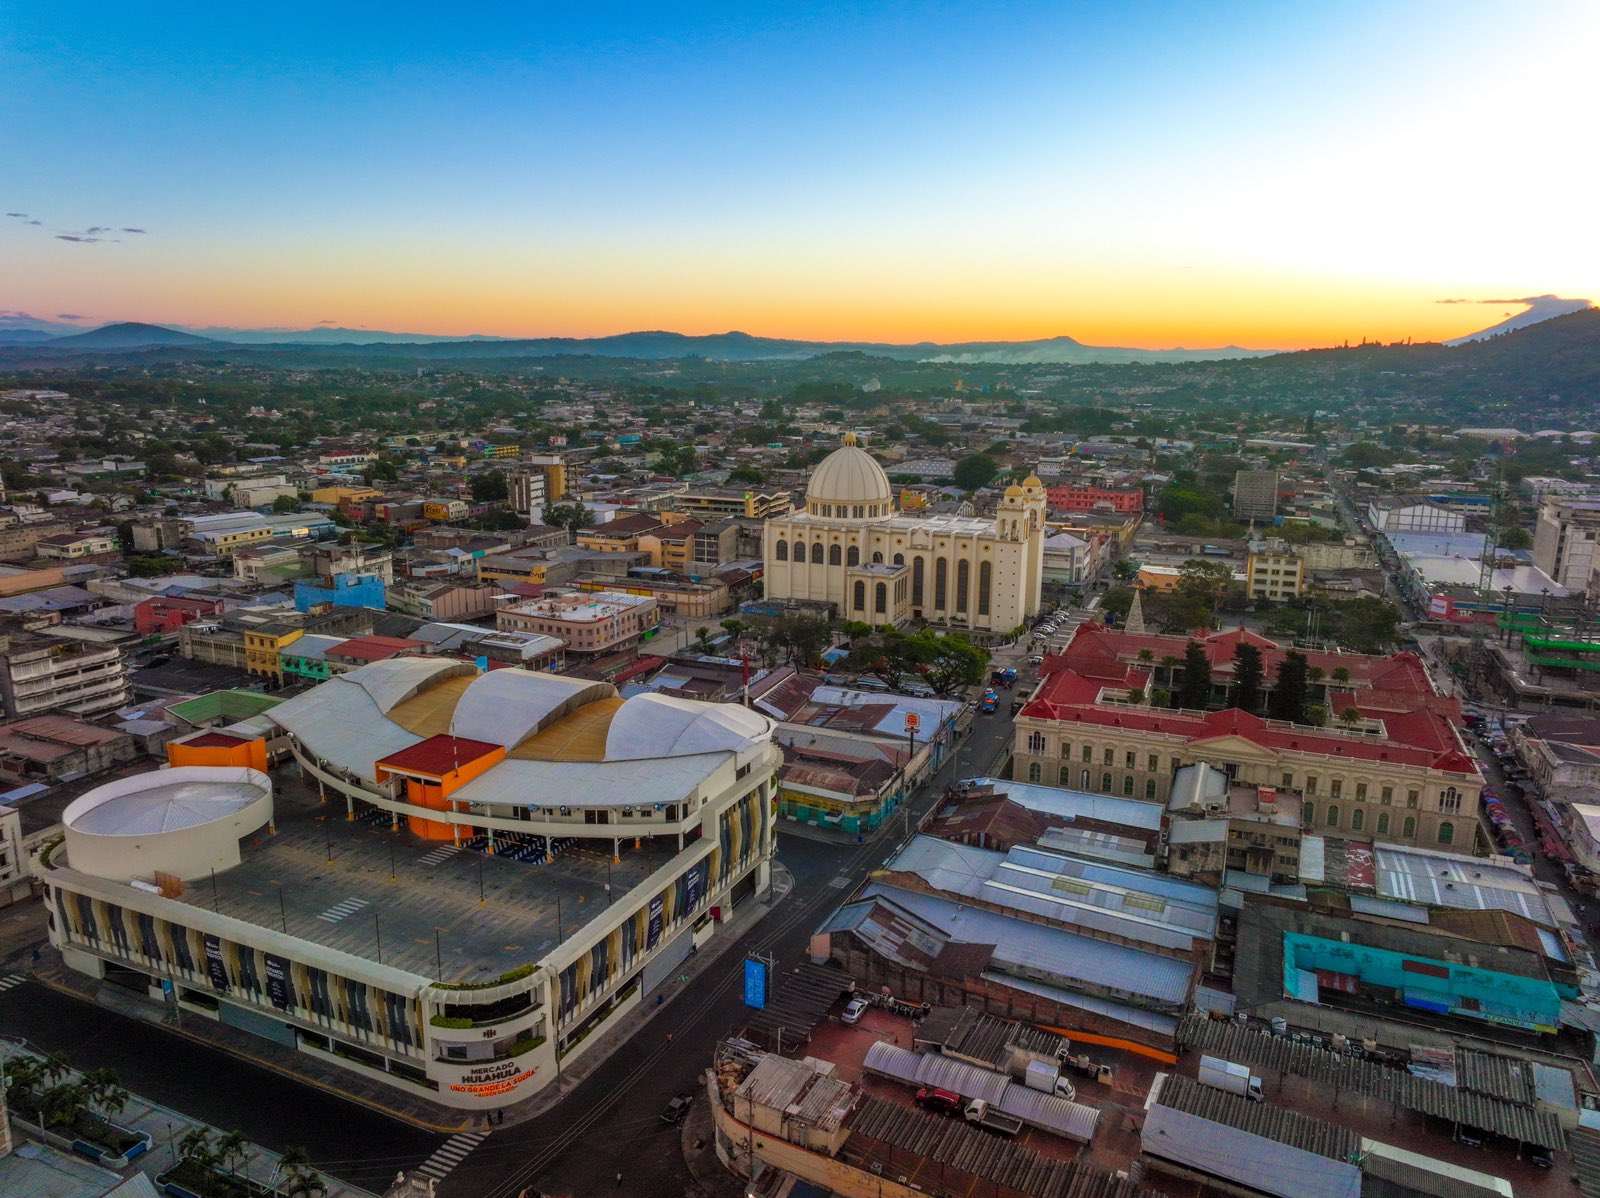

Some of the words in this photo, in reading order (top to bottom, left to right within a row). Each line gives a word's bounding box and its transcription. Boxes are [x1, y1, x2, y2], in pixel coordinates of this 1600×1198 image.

[471, 1062, 514, 1074] MERCADO
[462, 1067, 521, 1083] HULAHULA
[450, 1084, 466, 1093] UNO
[467, 1083, 500, 1093] GRANDE
[501, 1081, 512, 1089] LA
